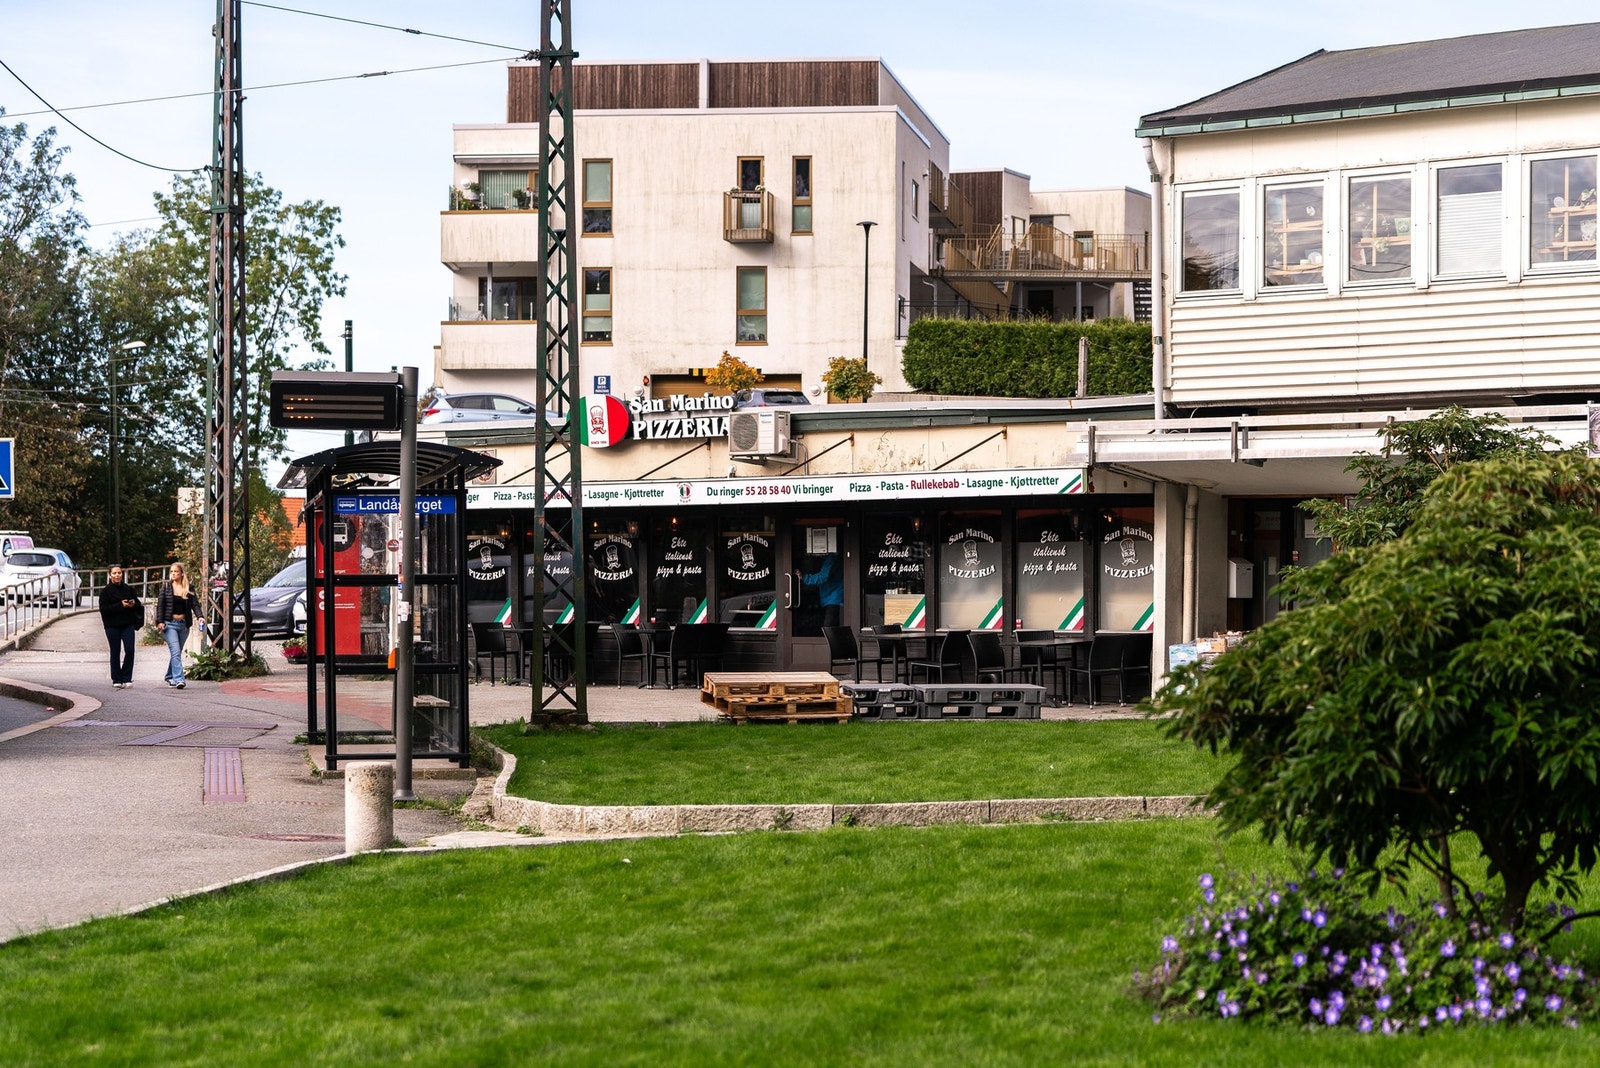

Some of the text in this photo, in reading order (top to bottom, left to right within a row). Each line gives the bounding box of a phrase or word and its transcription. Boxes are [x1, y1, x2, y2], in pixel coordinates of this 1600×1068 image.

[630, 393, 734, 412] San Marino
[706, 486, 719, 496] Du
[720, 486, 744, 498] ringer
[745, 486, 756, 496] 55
[757, 485, 768, 495] 28
[769, 485, 780, 495] 58
[780, 484, 791, 495] 40
[792, 483, 802, 494] Vi
[803, 483, 834, 496] bringer
[849, 481, 872, 493] Pizza
[881, 480, 904, 492] Pasta
[910, 478, 960, 491] Rullekebab
[966, 478, 1004, 490] Lasagne
[1010, 475, 1060, 489] Kjøttretter
[493, 491, 512, 501] Pizza
[517, 490, 536, 500] Pasta
[588, 489, 619, 502] Lasagne
[624, 487, 665, 500] Kjøttretter
[359, 498, 443, 513] Landårget
[608, 534, 633, 549] Marino
[743, 533, 769, 548] Marino
[965, 528, 994, 544] Marino
[1122, 526, 1154, 542] Marino
[482, 535, 505, 549] Marino
[469, 568, 506, 580] PIZZERIA
[594, 567, 634, 580] PIZZERIA
[683, 564, 702, 577] pasta
[727, 566, 770, 580] PIZZERIA
[898, 563, 920, 576] pasta
[948, 564, 996, 578] PIZZERIA
[1054, 561, 1078, 574] pasta
